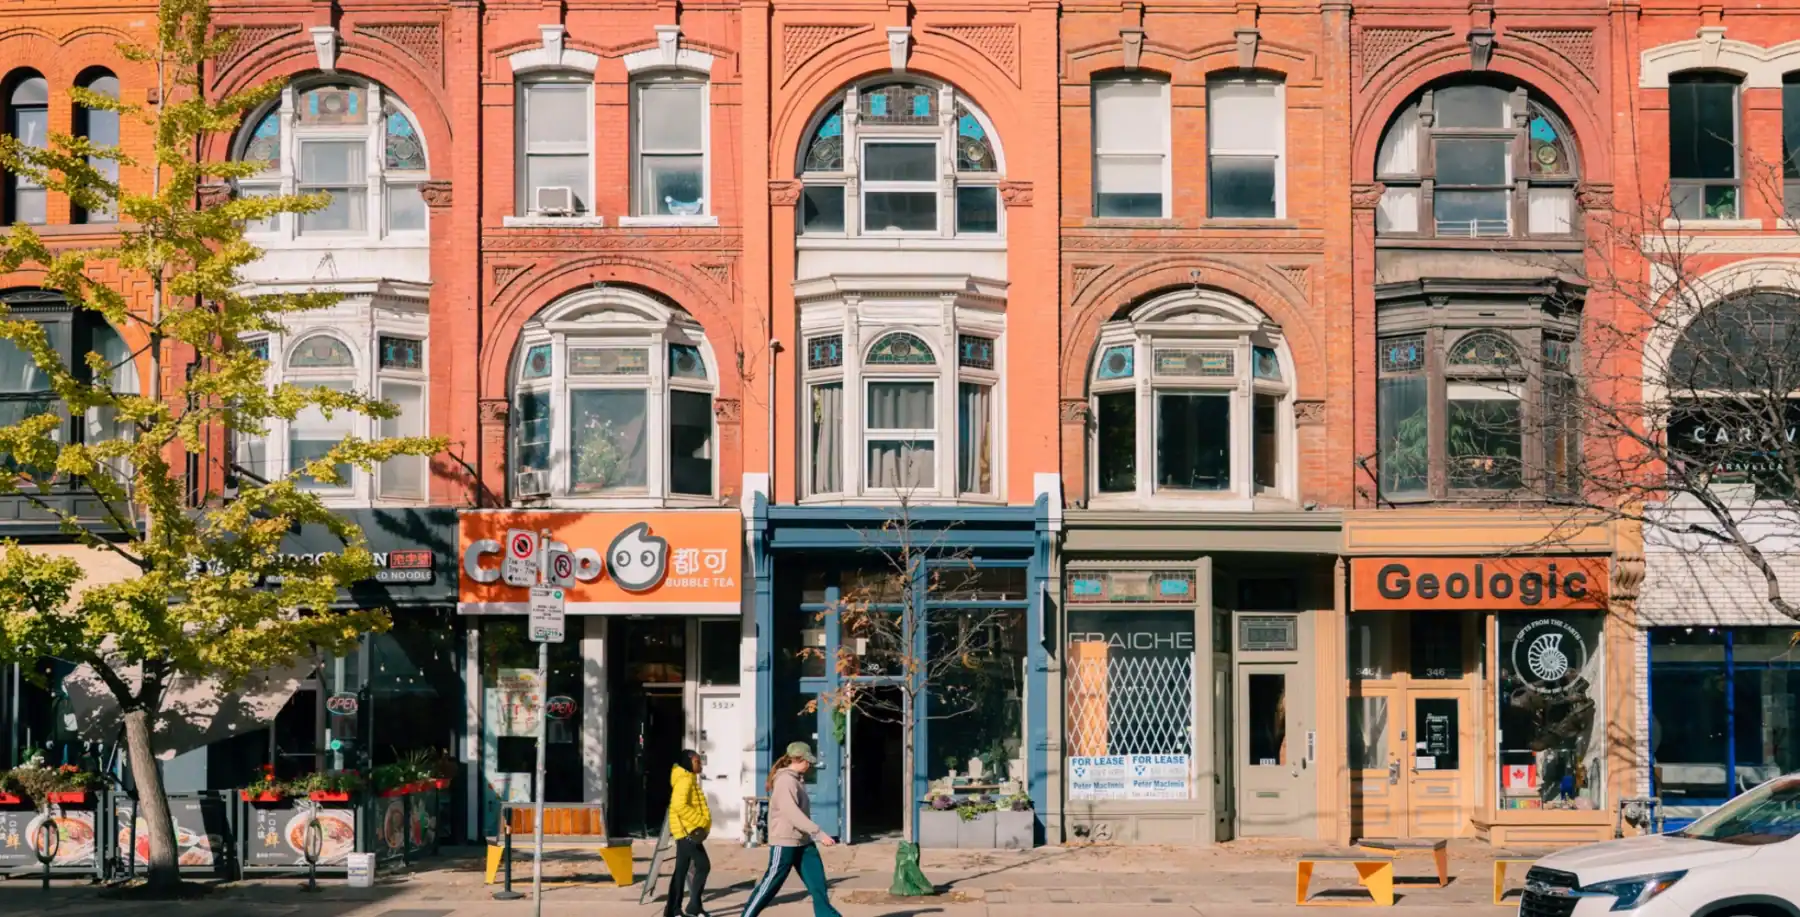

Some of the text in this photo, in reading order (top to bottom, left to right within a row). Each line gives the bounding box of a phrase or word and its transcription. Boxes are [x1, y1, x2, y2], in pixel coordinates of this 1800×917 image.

[672, 548, 728, 575] 都可
[391, 571, 433, 580] NOODLE
[665, 576, 736, 588] BUBBLE TEA
[1377, 564, 1588, 605] Geologic
[1516, 619, 1582, 641] GIFTS FROM THE EARTH
[1426, 667, 1446, 677] 346
[1072, 757, 1124, 766] FOR LEASE
[1133, 756, 1185, 764] FOR LEASE
[1073, 782, 1092, 790] Peter
[1133, 780, 1152, 788] Peter
